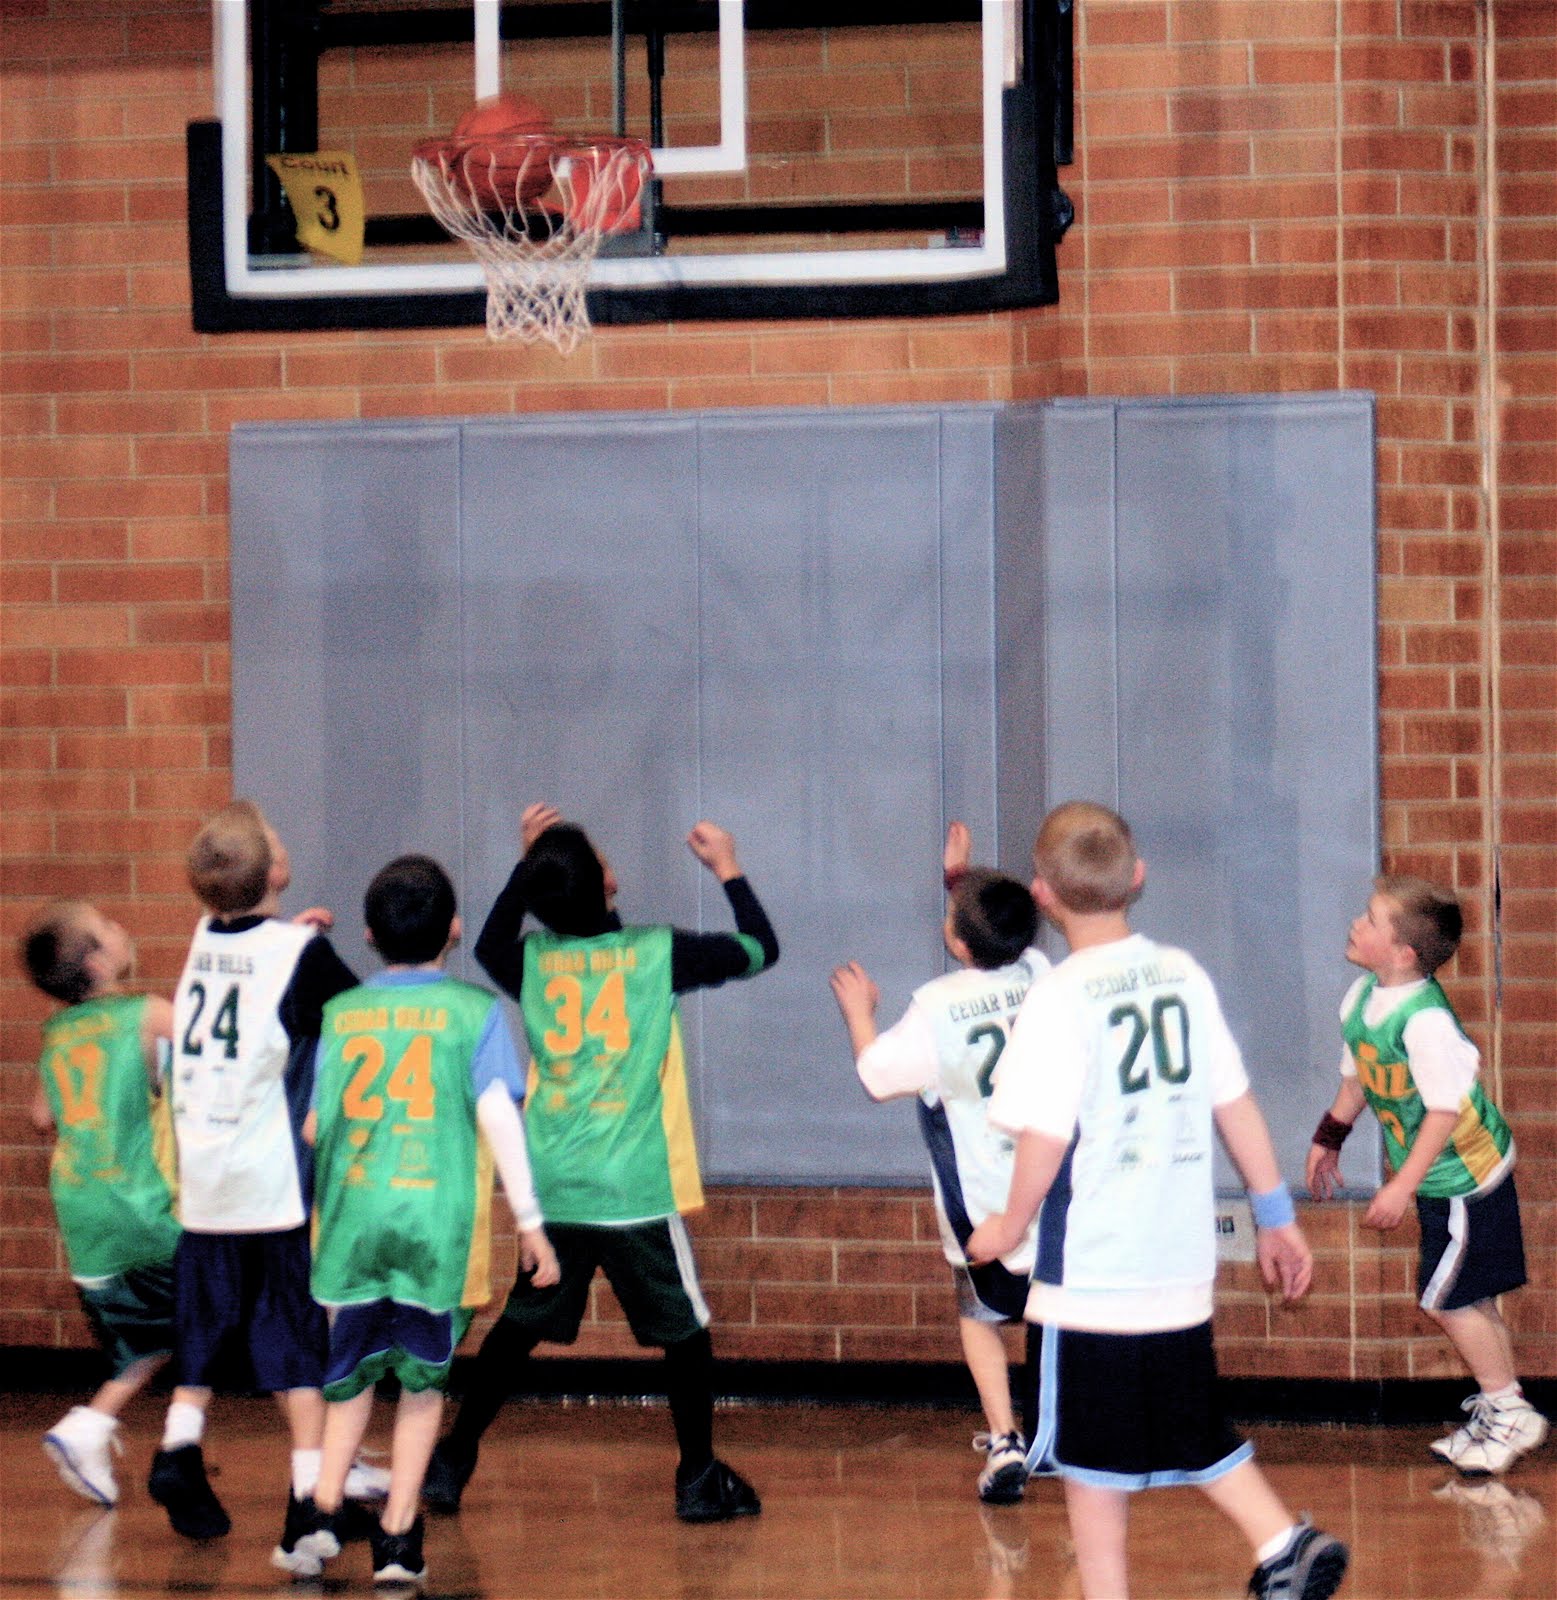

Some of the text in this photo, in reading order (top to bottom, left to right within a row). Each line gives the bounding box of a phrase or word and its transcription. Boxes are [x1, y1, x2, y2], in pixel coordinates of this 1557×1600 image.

[314, 185, 340, 231] 3
[182, 980, 240, 1060] 24
[543, 973, 631, 1055] 34
[948, 992, 1001, 1022] CEDAR
[1107, 993, 1192, 1095] 20
[342, 1035, 436, 1120] 24
[966, 1016, 1018, 1098] 2
